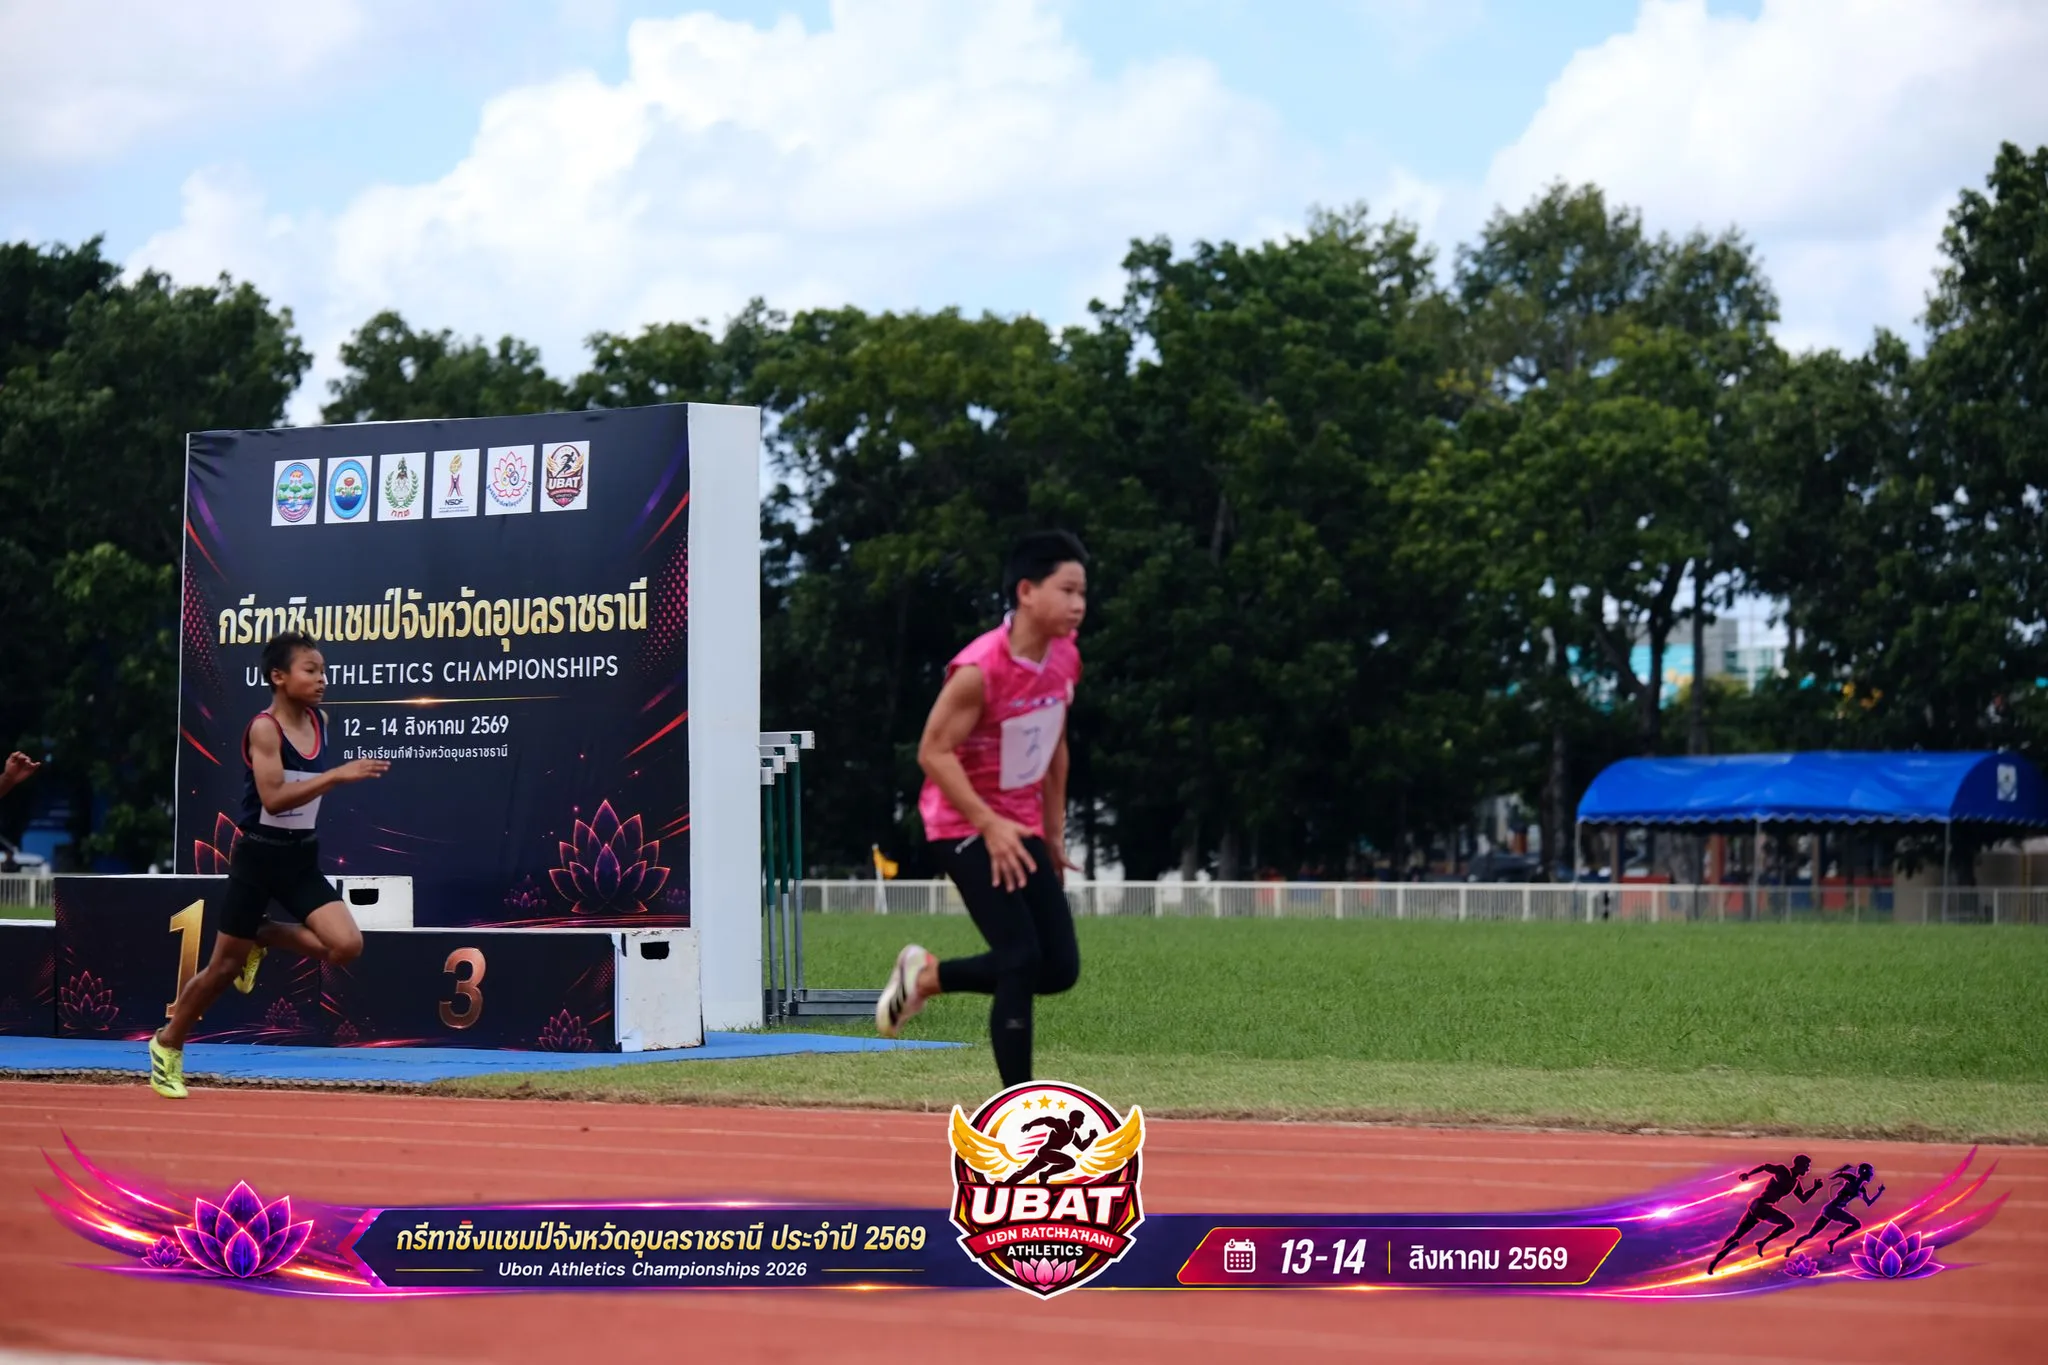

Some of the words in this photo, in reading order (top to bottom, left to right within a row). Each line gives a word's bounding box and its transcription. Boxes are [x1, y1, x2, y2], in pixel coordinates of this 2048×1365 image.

[548, 476, 581, 490] UBAT
[443, 655, 619, 683] CHAMPIONSHIPS
[344, 717, 361, 738] 12
[381, 717, 398, 737] 14
[404, 715, 465, 737] สิงหาคม
[471, 714, 510, 735] 2569
[343, 748, 354, 760] ณ
[166, 898, 206, 1021] 1
[438, 946, 487, 1030] 3
